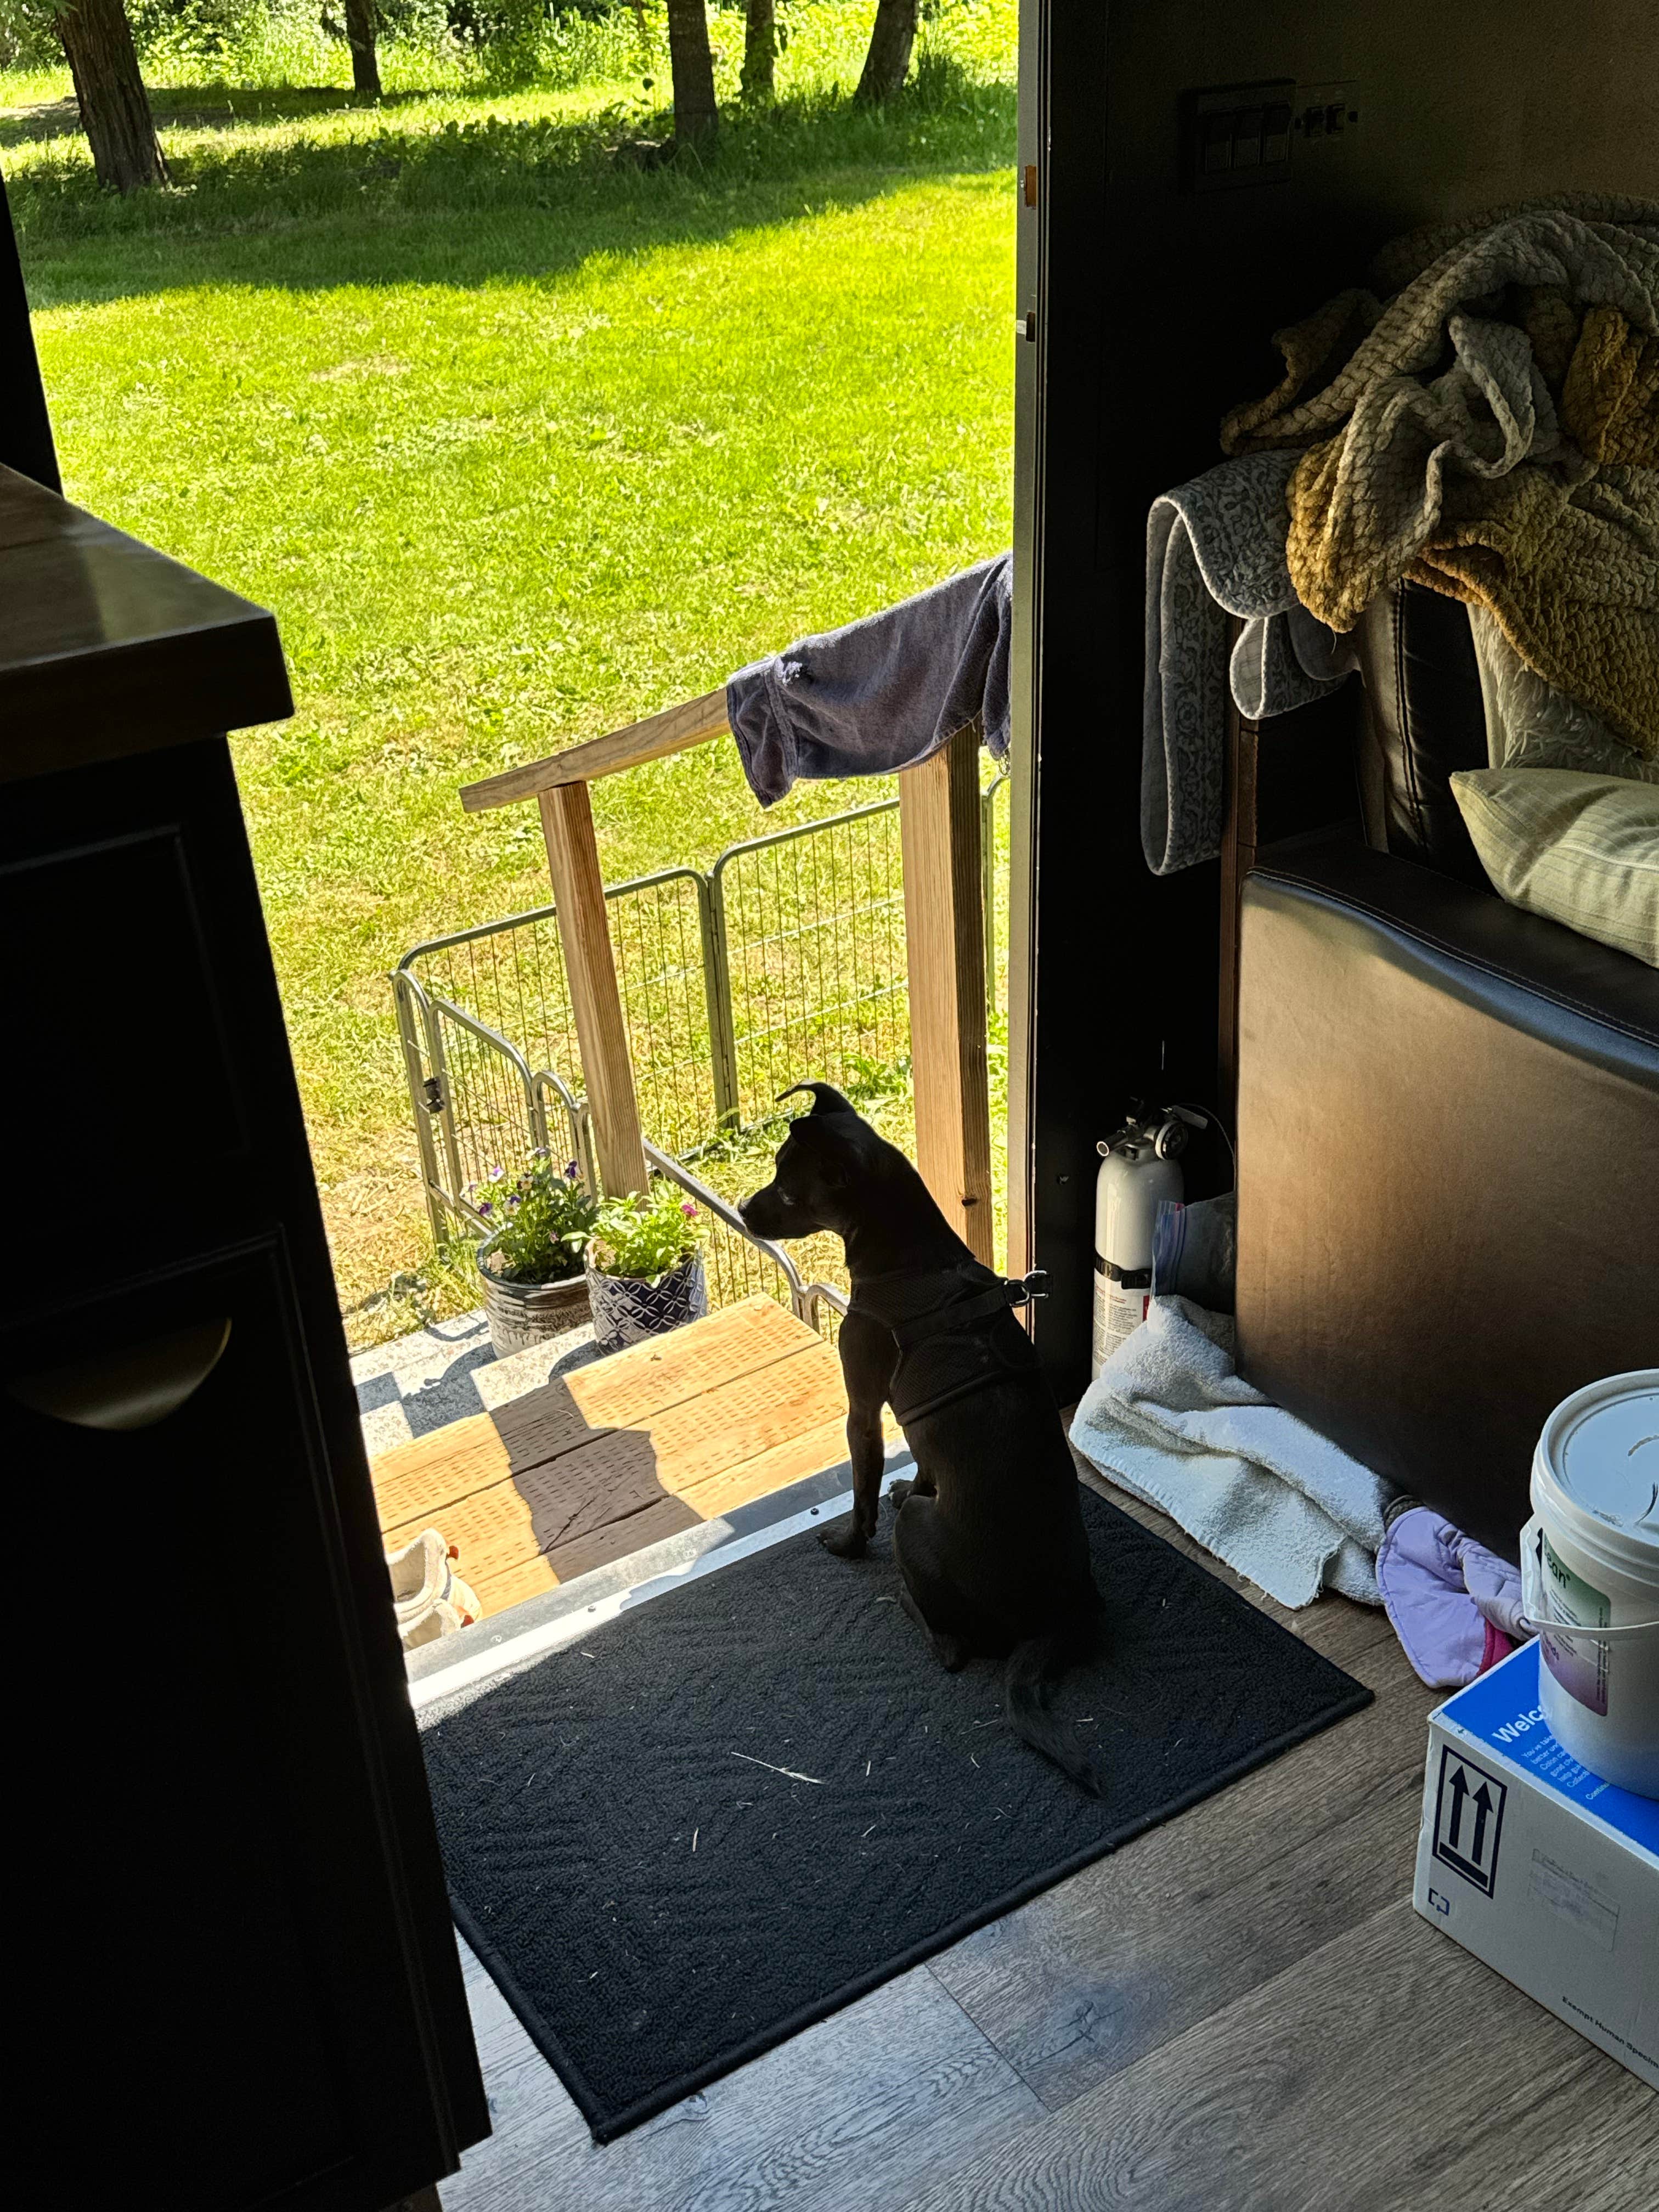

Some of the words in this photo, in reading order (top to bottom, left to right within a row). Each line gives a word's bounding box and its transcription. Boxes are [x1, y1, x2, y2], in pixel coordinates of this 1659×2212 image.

[1562, 1996, 1594, 2023] Exempt
[1595, 2019, 1625, 2045] Human
[1626, 2042, 1659, 2069] Specim
